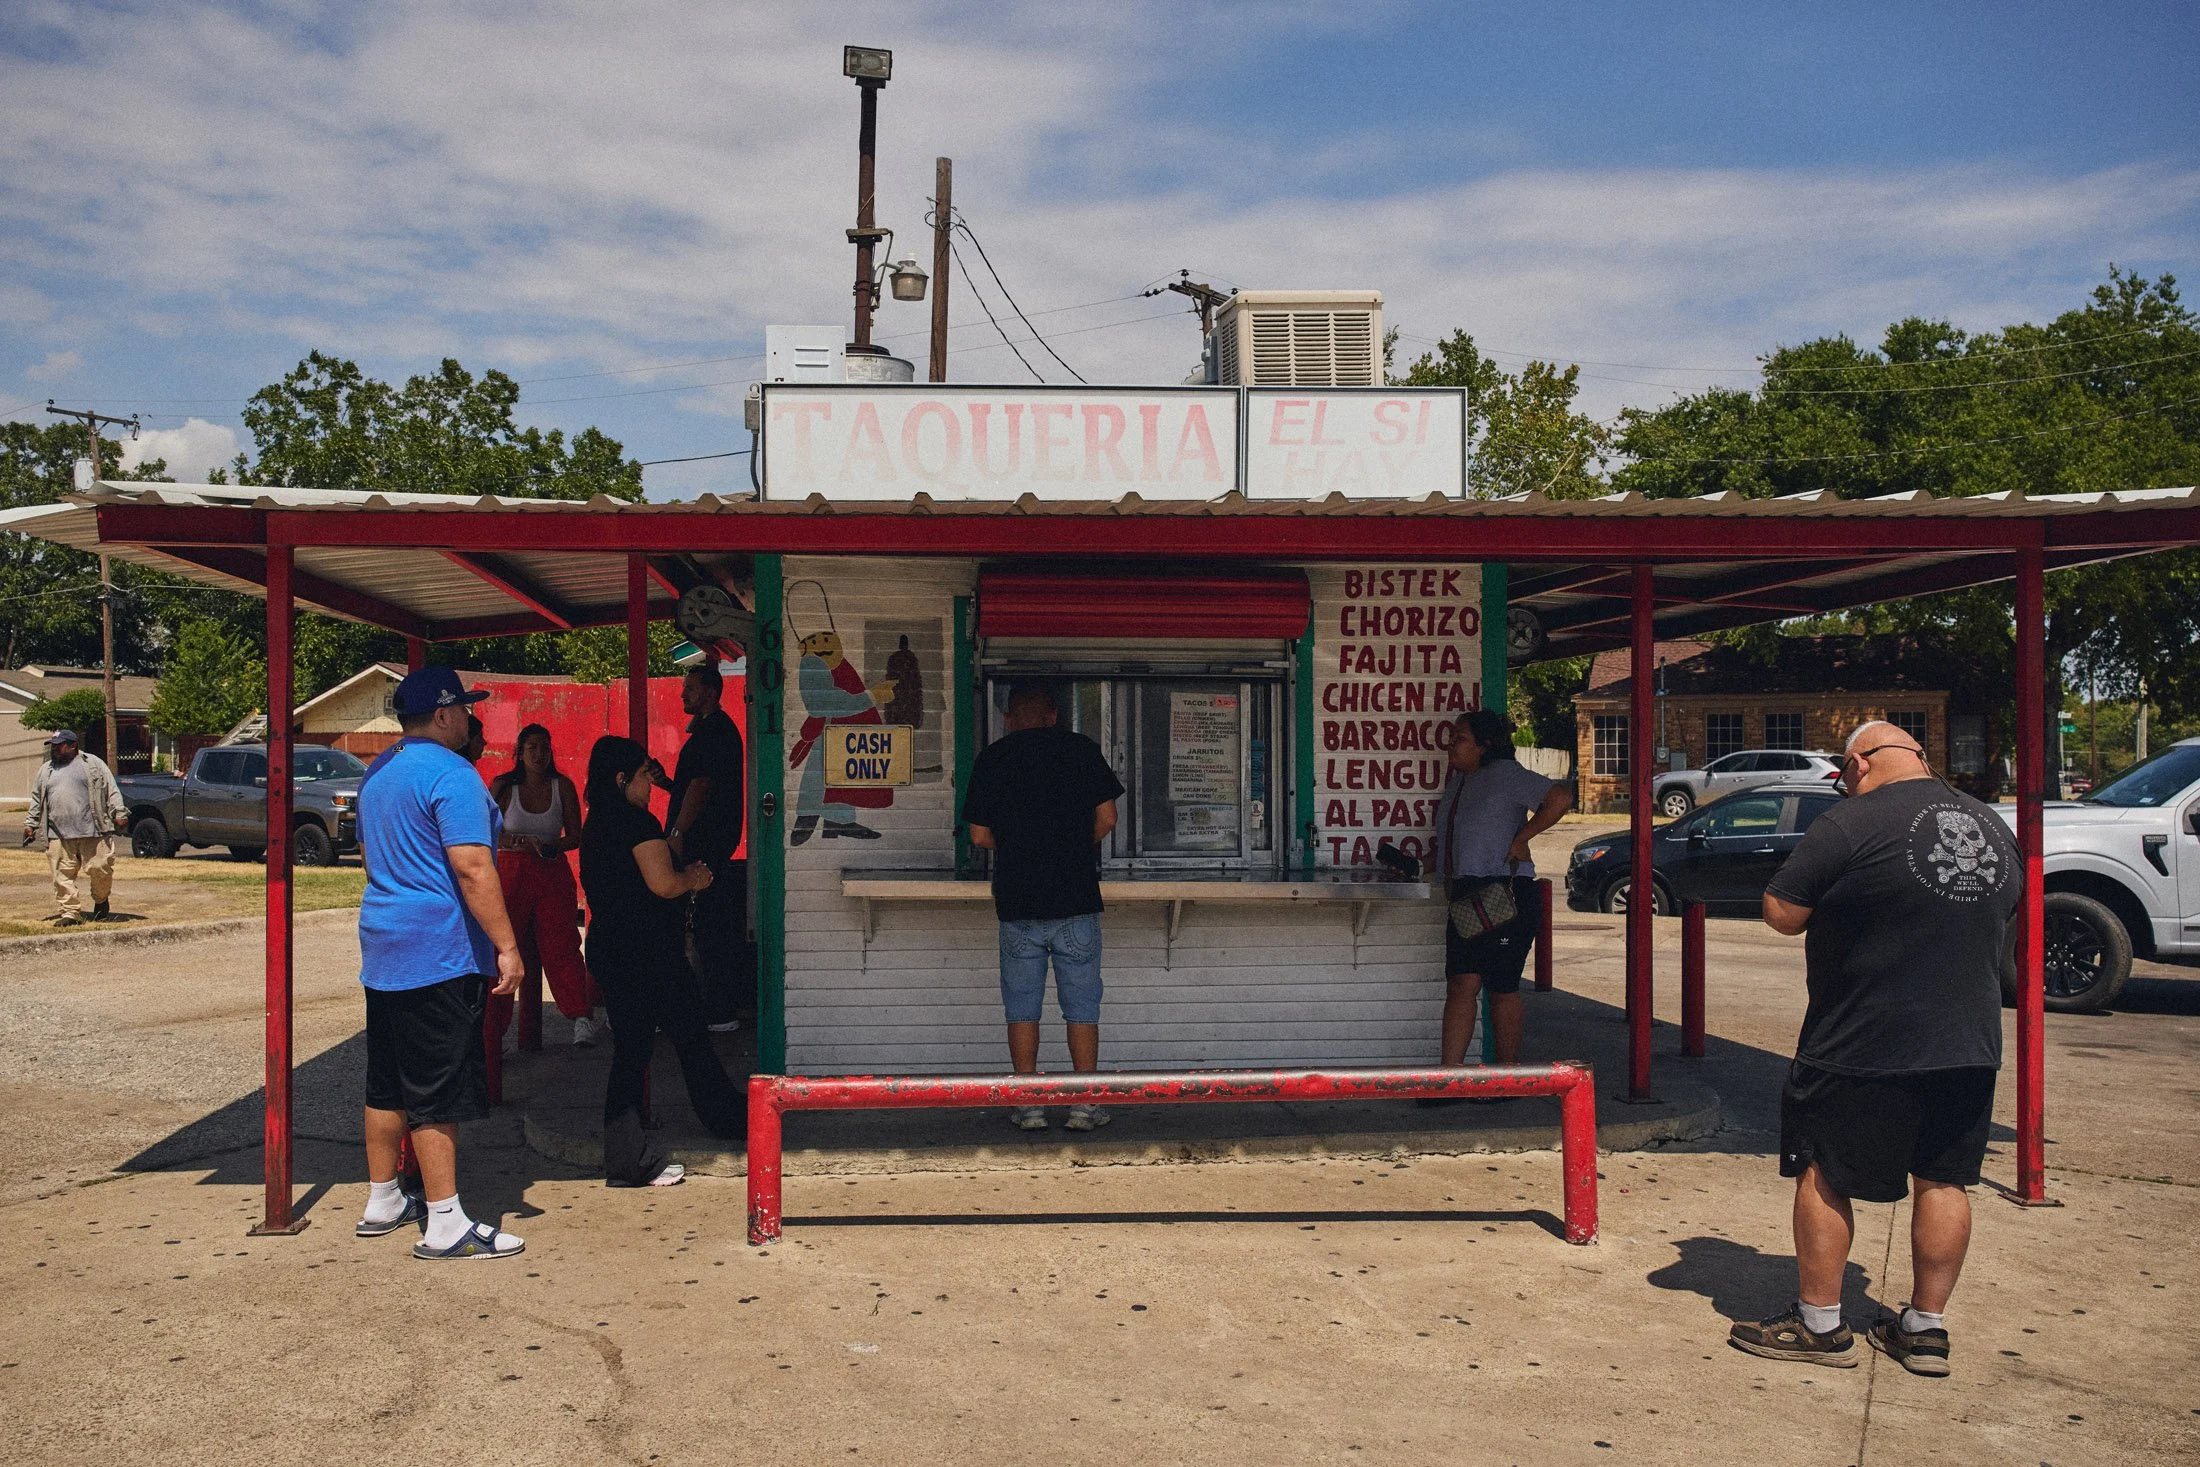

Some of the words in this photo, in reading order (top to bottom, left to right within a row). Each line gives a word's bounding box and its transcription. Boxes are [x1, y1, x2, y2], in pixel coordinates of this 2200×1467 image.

[1268, 400, 1345, 445] EL
[1369, 400, 1432, 445] SI
[773, 402, 1225, 489] TAQUERIA
[1283, 451, 1419, 495] HAY
[1344, 569, 1462, 599] BISTEK
[1340, 606, 1480, 637] CHORIZO
[1339, 645, 1462, 676] FAJITA
[759, 619, 783, 735] 601
[1322, 682, 1425, 713] CHICEN
[845, 732, 892, 754] CASH
[845, 757, 891, 780] ONLY
[1326, 759, 1452, 790] LENGU
[1325, 799, 1364, 827] AL
[1910, 808, 1929, 833] PRIDE
[1906, 848, 1932, 888] COUNTRY
[1933, 887, 1945, 896] IN
[1948, 893, 1978, 902] PRIDE
